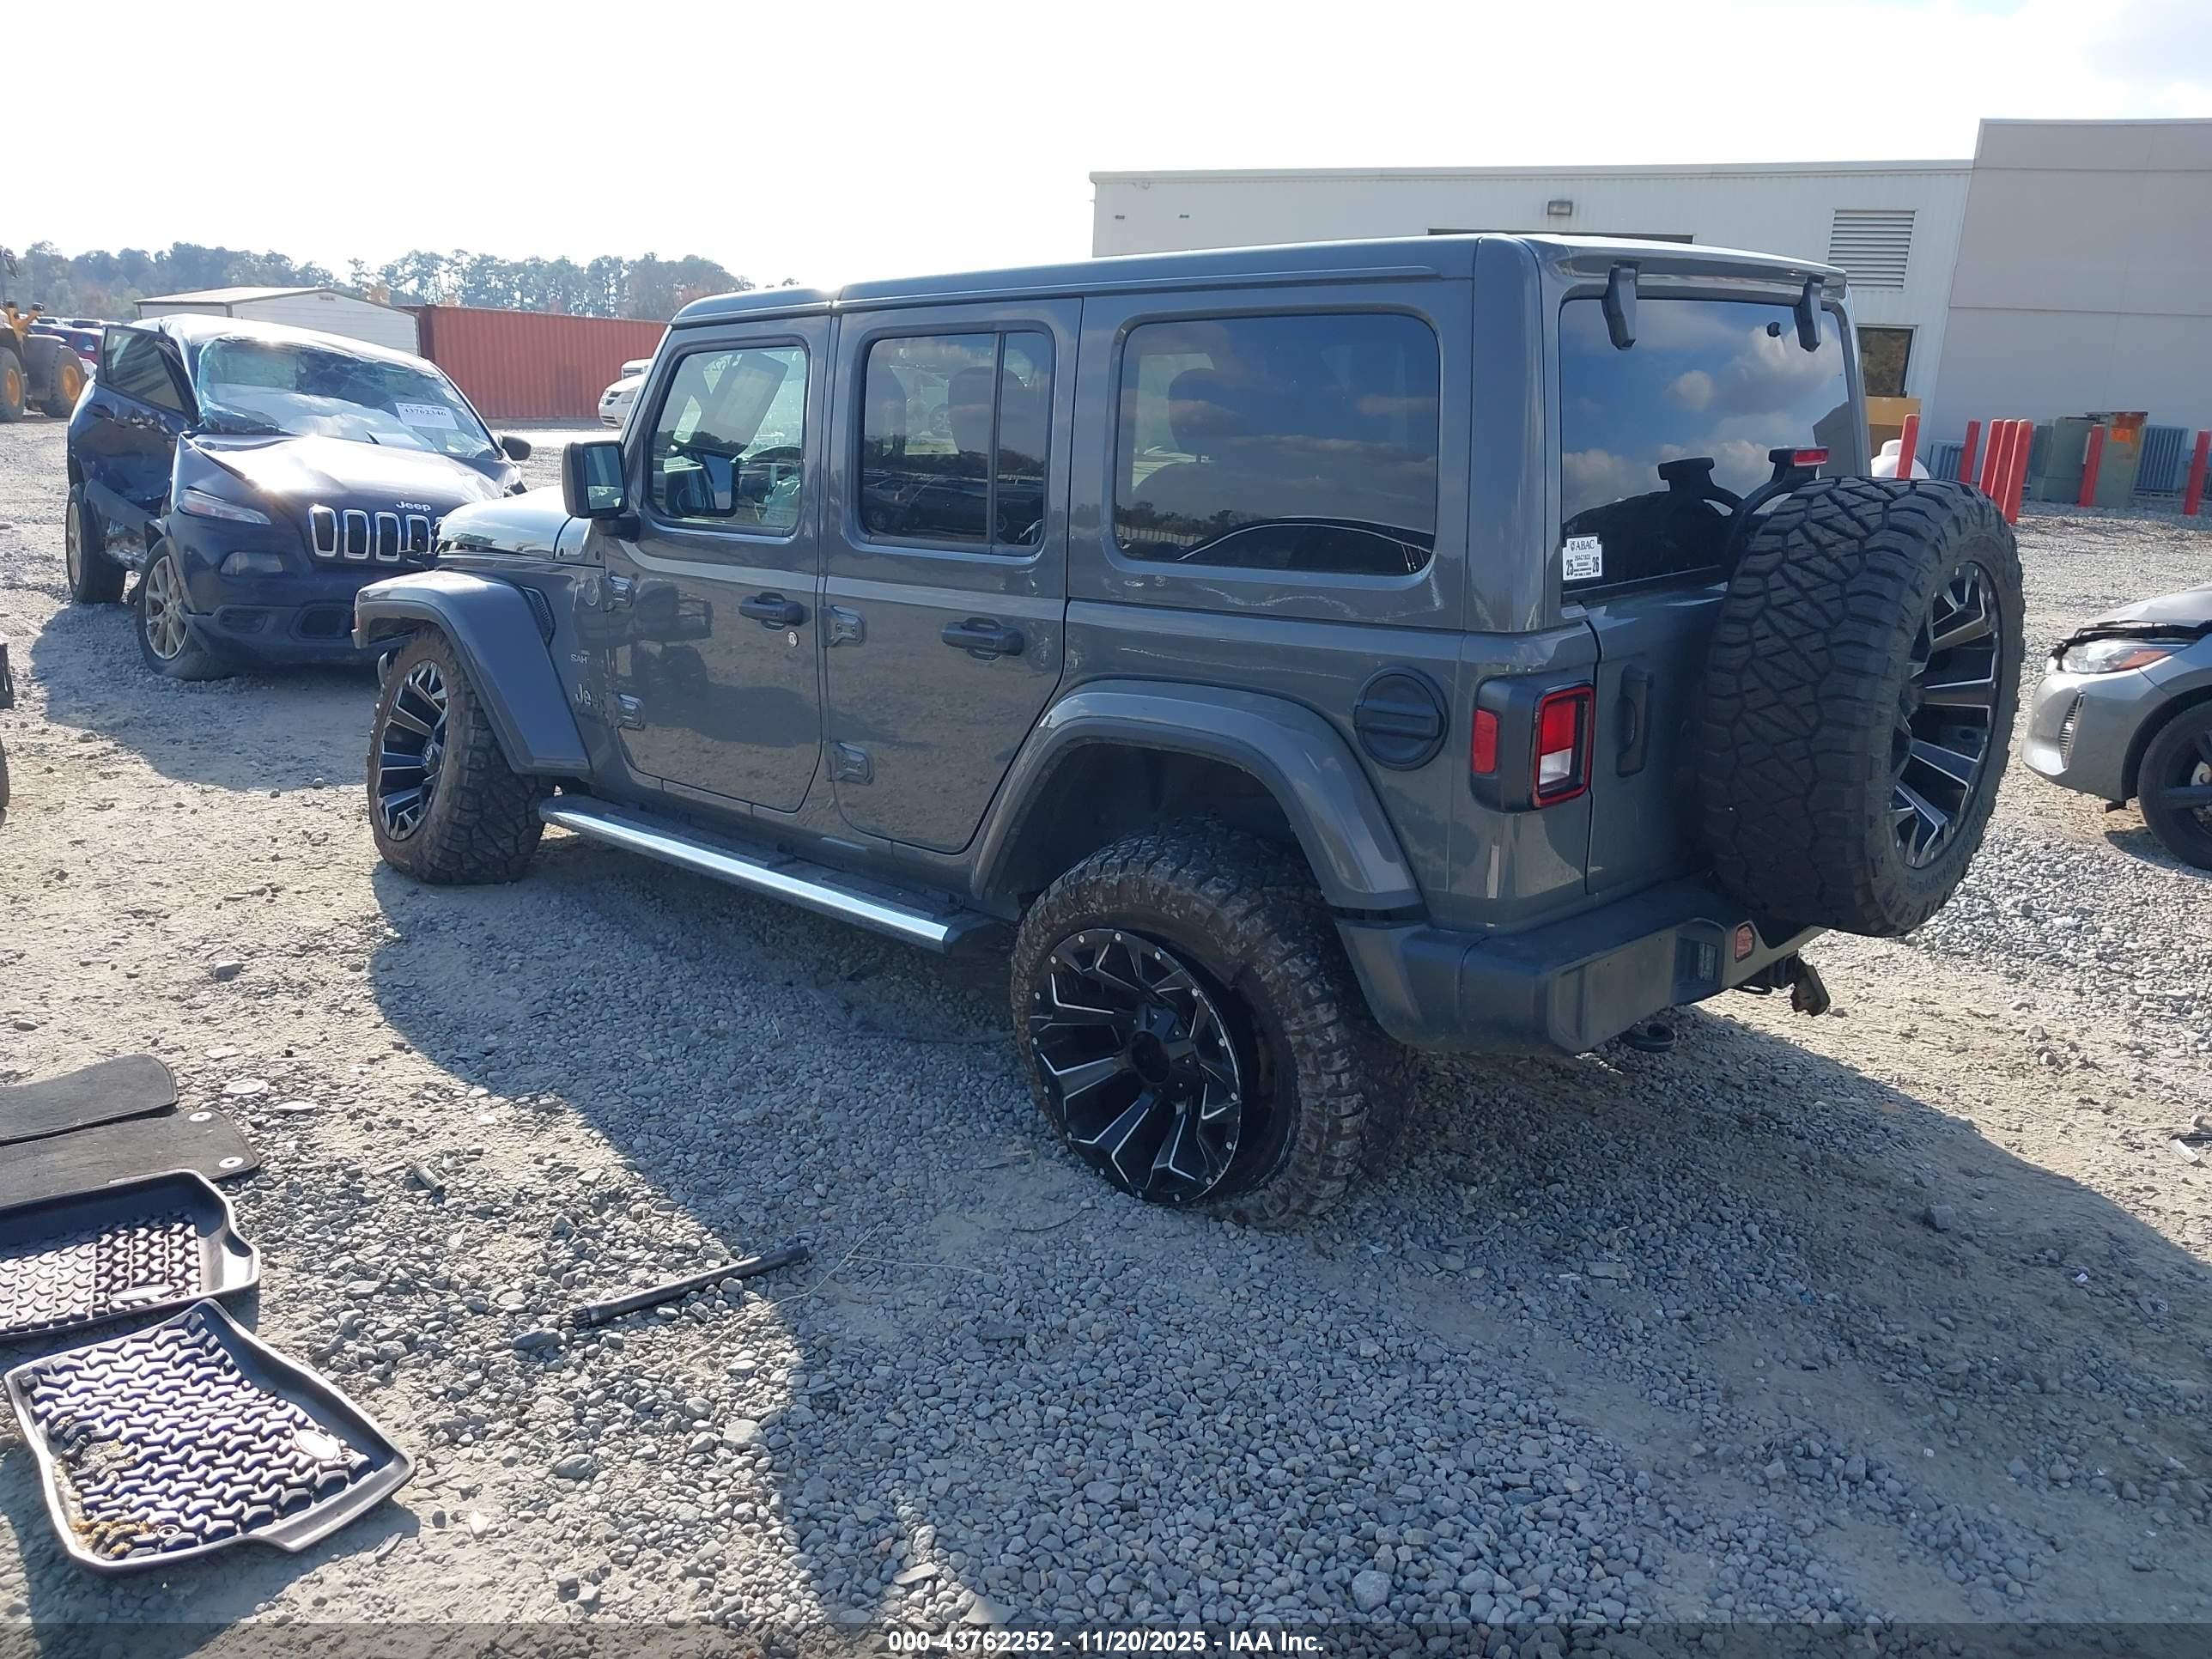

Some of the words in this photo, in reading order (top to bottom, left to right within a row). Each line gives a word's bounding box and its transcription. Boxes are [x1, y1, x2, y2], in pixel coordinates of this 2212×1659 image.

[396, 501, 431, 512] Jeep
[1576, 540, 1595, 550] ABAC
[1566, 559, 1574, 576] 25
[1592, 556, 1600, 573] 26
